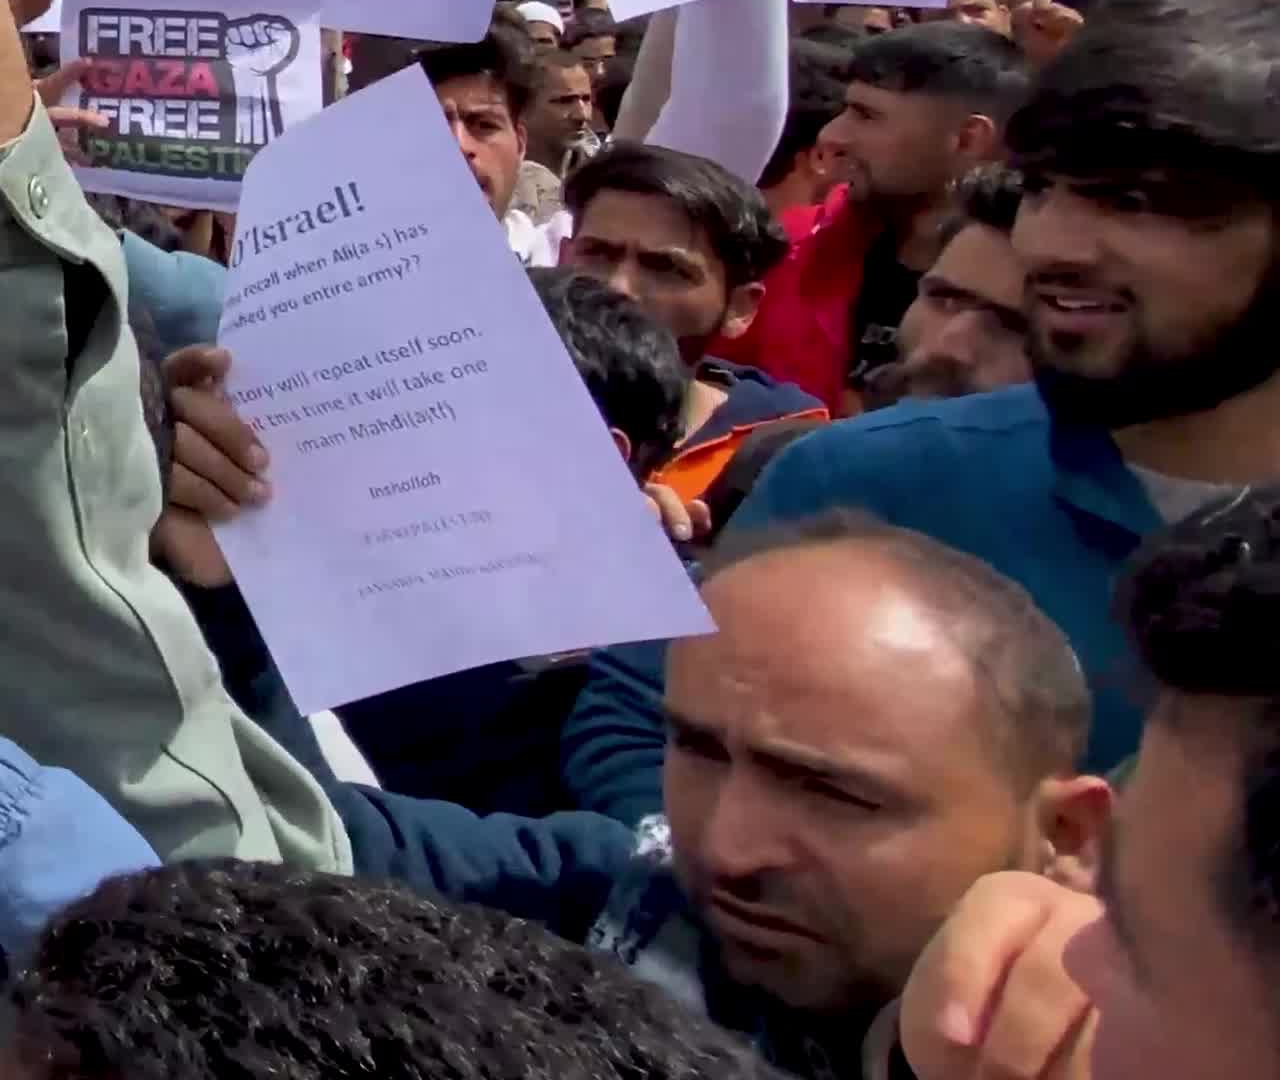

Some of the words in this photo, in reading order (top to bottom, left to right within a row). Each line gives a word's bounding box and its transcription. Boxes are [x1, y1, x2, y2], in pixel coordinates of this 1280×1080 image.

[87, 15, 221, 59] FREE
[90, 60, 221, 96] GAZA
[89, 98, 221, 140] FREE
[91, 139, 255, 173] PALESTI
[243, 271, 281, 298] recall
[284, 256, 328, 282] when
[394, 222, 430, 245] has
[269, 297, 299, 320] you
[302, 278, 354, 307] entire
[357, 253, 422, 290] army??
[277, 369, 311, 394] will
[313, 354, 373, 383] repeat
[427, 325, 484, 351] soon.
[347, 391, 361, 408] it
[366, 380, 400, 405] will
[403, 369, 447, 393] take
[450, 358, 489, 381] one
